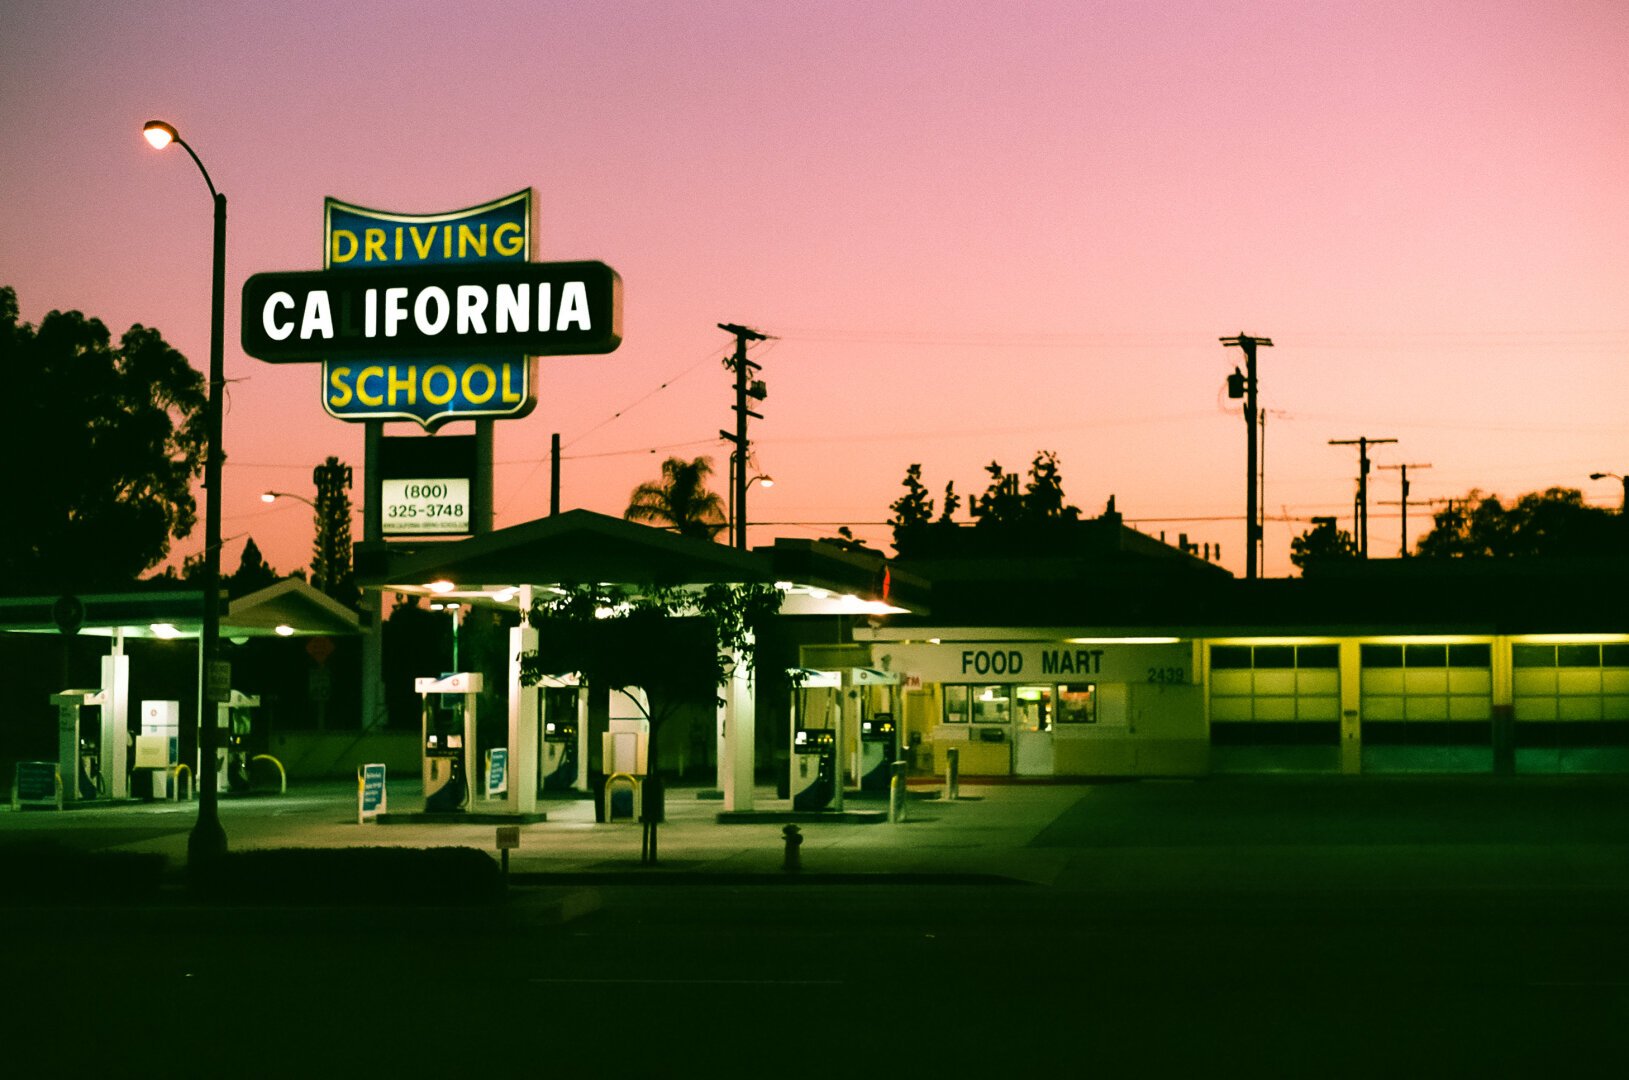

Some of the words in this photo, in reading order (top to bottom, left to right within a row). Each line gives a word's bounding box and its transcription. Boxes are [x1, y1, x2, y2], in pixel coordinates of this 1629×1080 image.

[332, 222, 525, 263] DRIVING
[330, 363, 521, 407] SCHOOL
[404, 483, 448, 499] (800)
[388, 504, 464, 518] 325-3748
[961, 650, 1023, 675] FOOD
[1042, 650, 1105, 675] MART
[1147, 667, 1186, 683] 2439
